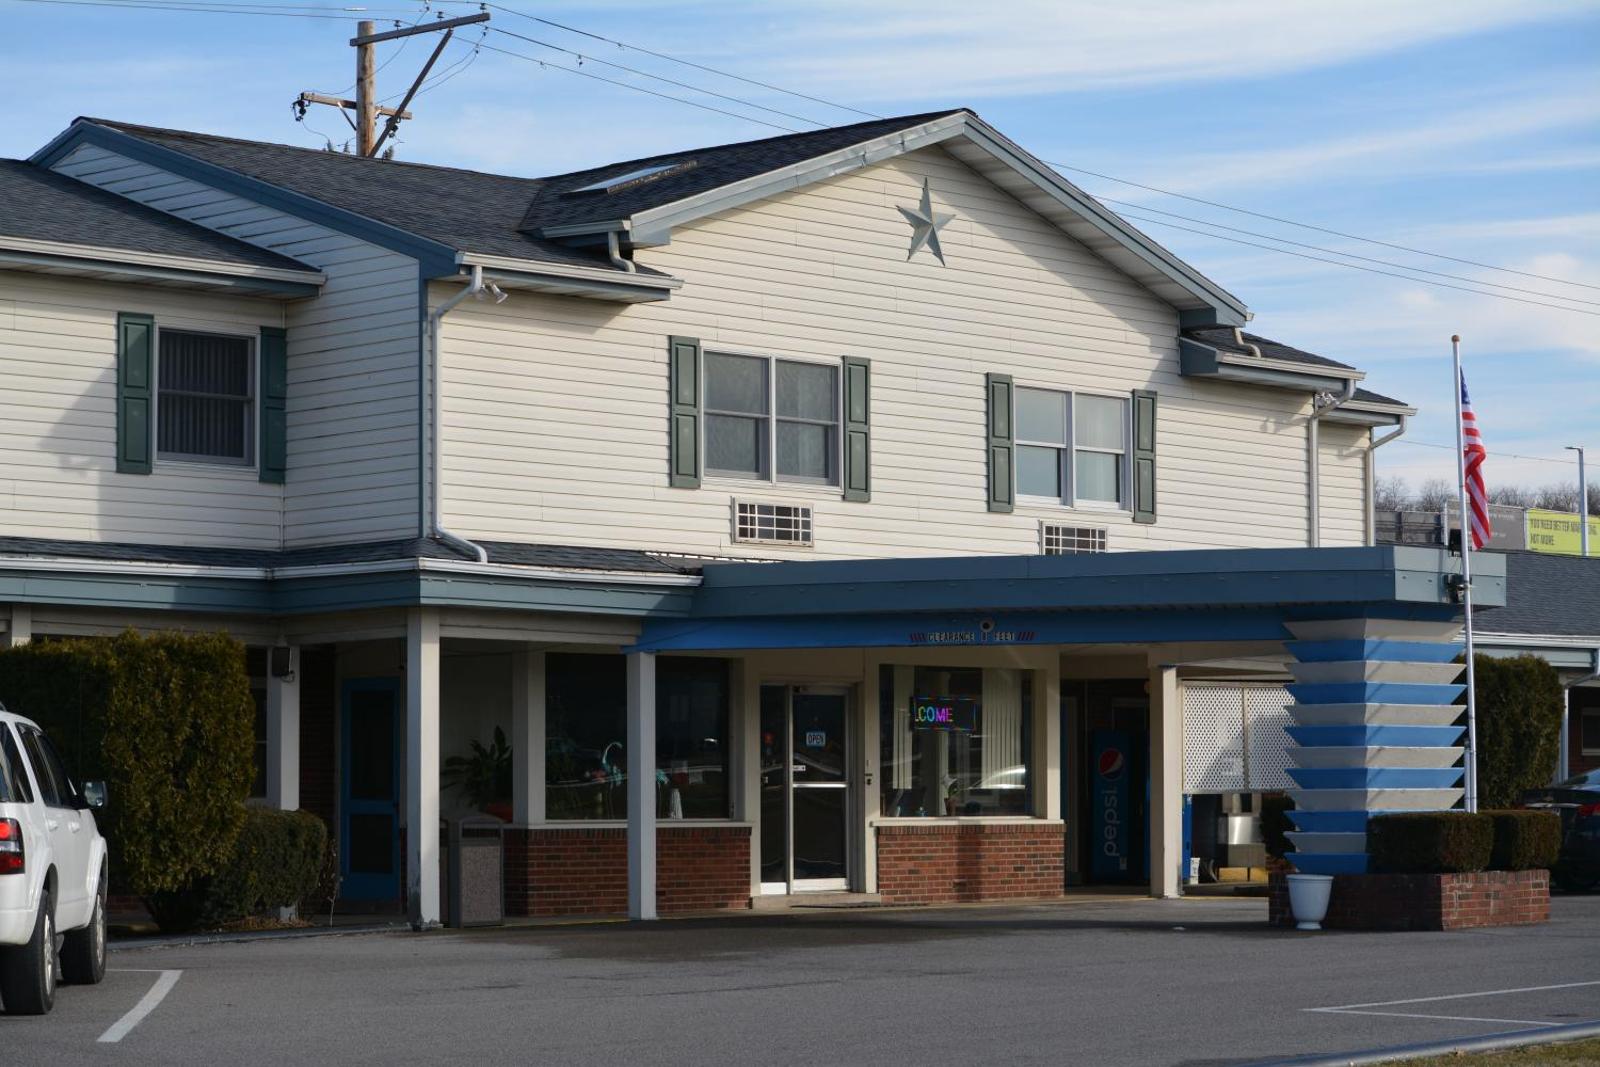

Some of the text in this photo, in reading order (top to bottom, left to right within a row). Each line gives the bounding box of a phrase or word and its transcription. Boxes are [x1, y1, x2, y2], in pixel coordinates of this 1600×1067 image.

[927, 631, 975, 641] CLEARANCE
[994, 631, 1014, 641] FEET
[807, 734, 824, 744] OPEN
[1102, 787, 1120, 857] pepsi
